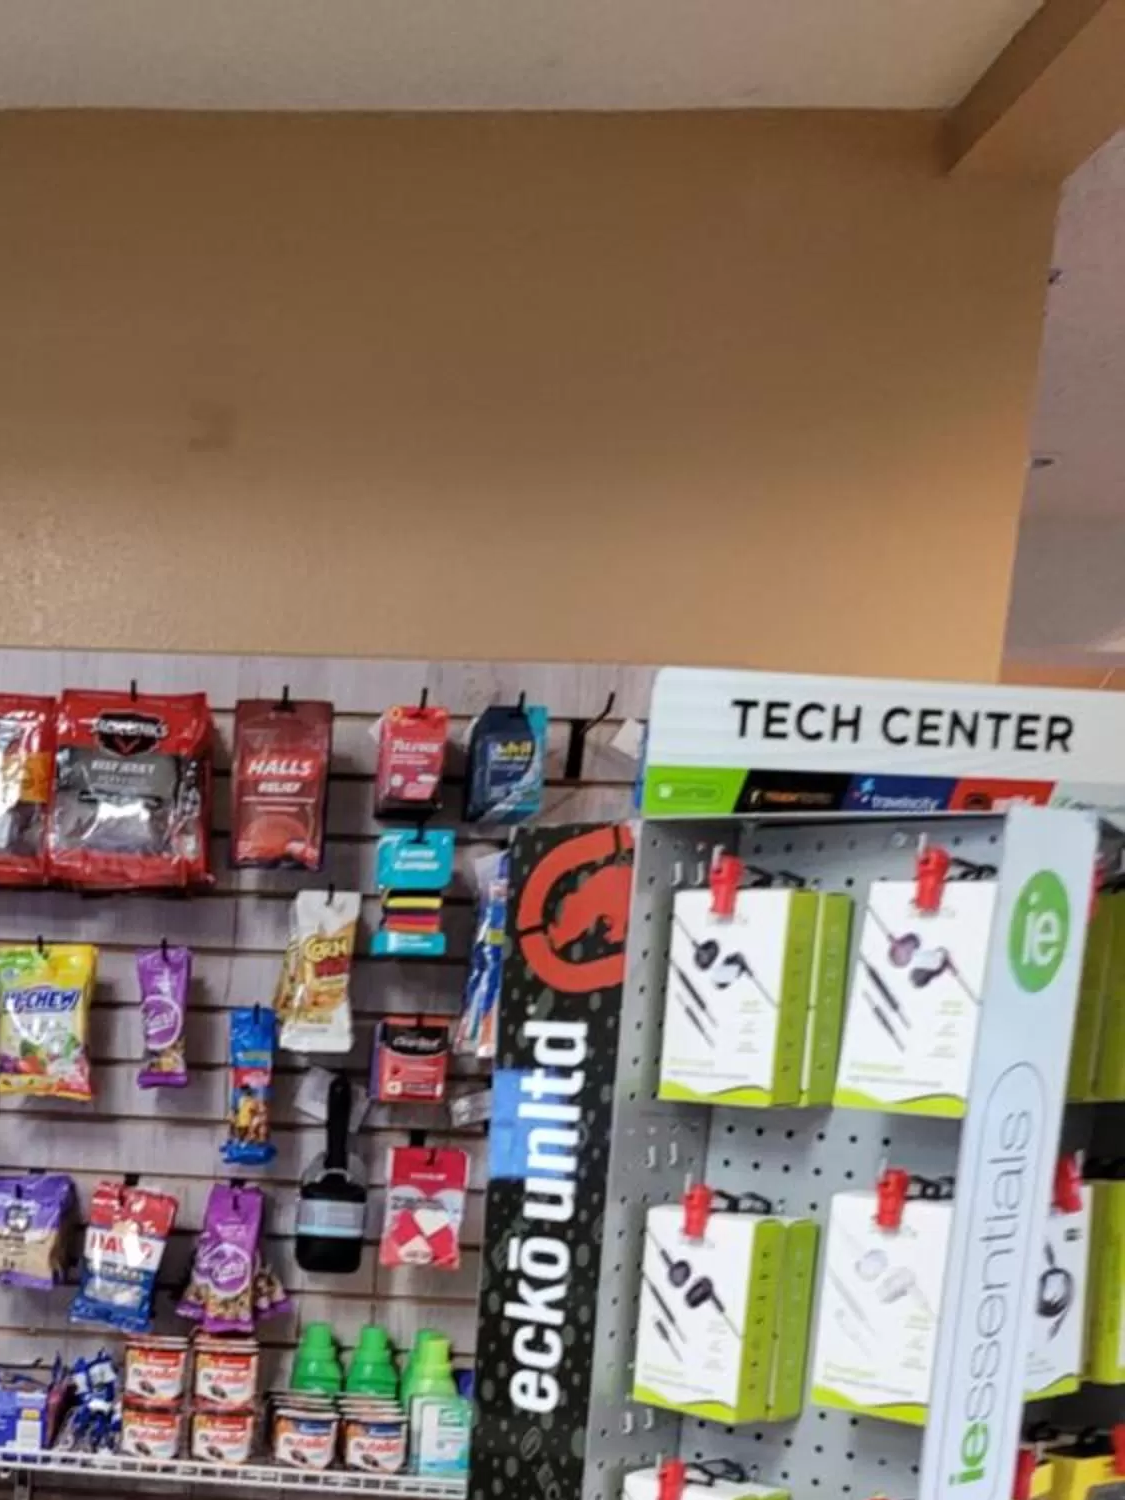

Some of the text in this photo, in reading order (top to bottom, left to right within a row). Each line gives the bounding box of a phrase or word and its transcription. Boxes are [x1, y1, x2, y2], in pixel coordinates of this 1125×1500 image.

[731, 699, 1074, 753] TECH CENTER
[247, 758, 314, 777] HALLS
[1020, 893, 1062, 967] ie
[516, 1020, 589, 1223] unltd
[948, 1109, 1034, 1488] iessentials
